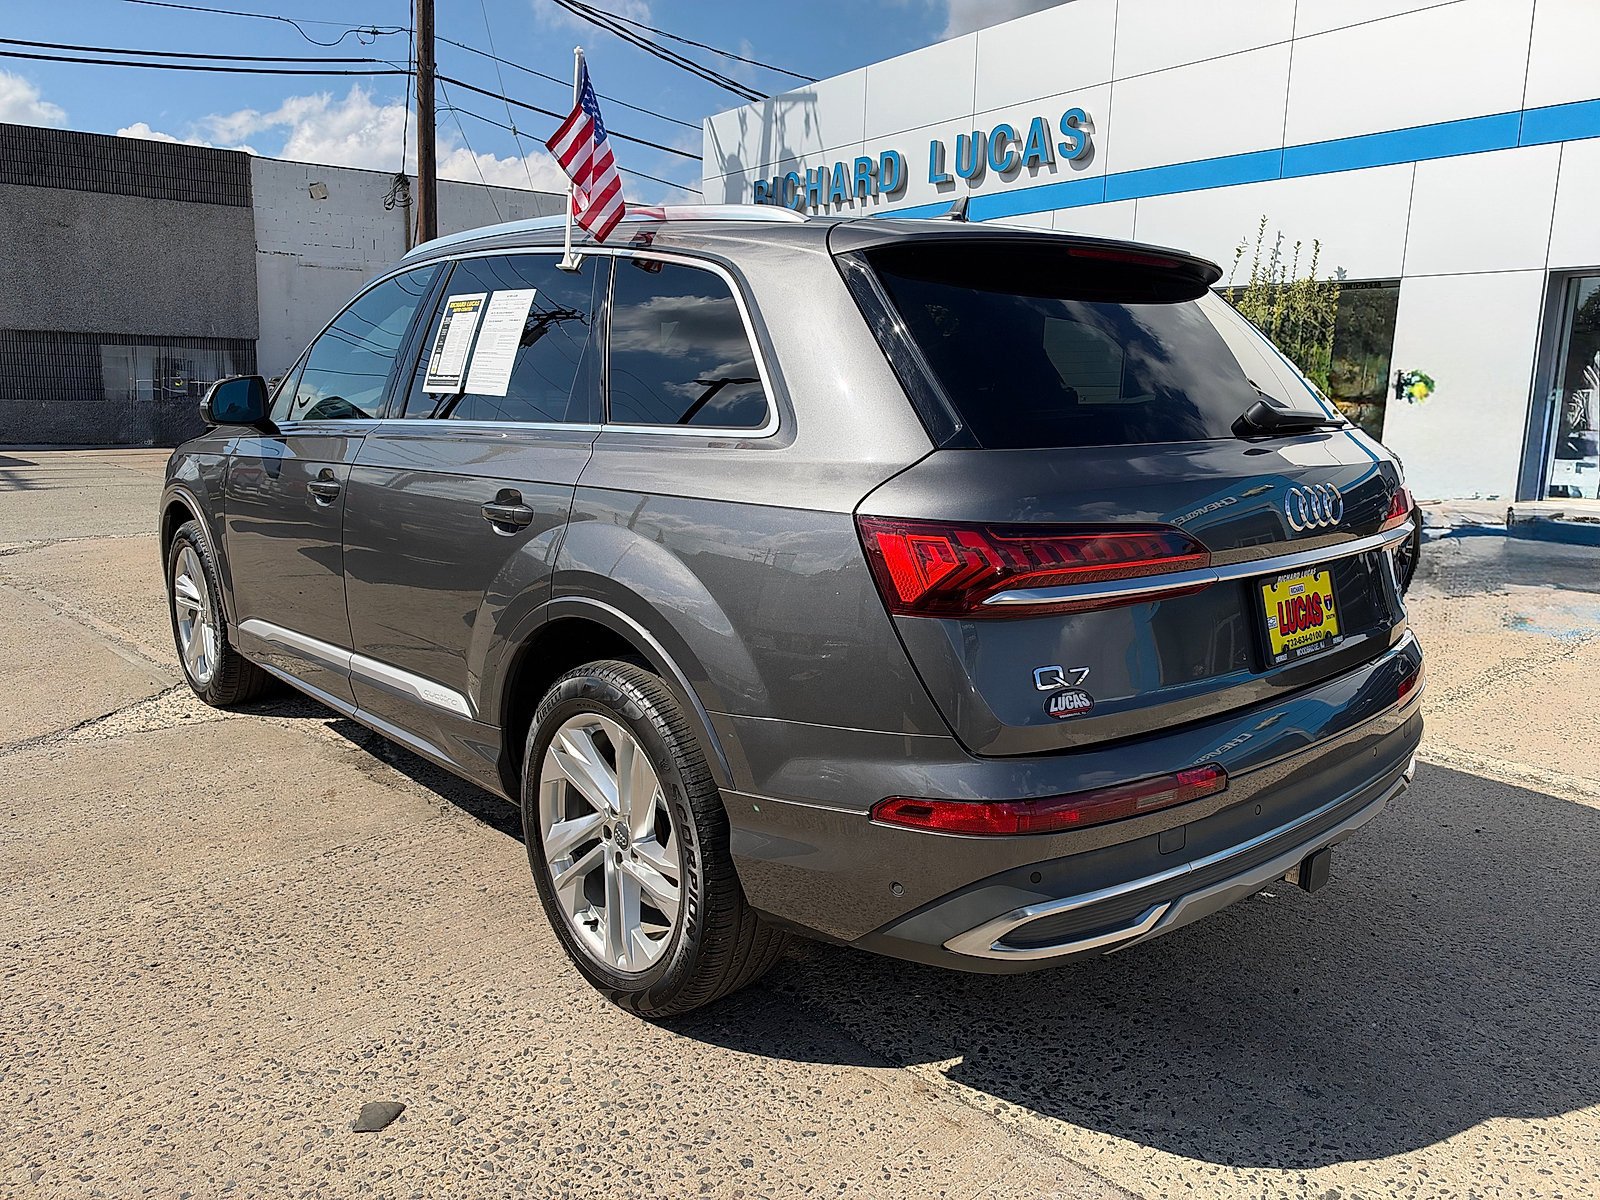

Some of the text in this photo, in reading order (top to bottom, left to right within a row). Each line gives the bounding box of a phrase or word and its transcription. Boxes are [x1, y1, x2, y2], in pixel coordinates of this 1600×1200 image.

[753, 107, 1094, 211] RICHARD LUCAS
[450, 301, 466, 309] RICHARD
[1277, 568, 1316, 583] RICHARD LUCAS
[1277, 592, 1323, 637] LUCAS
[1326, 600, 1331, 610] 1
[1287, 630, 1322, 647] 732-634-0100
[1032, 665, 1090, 691] Q7
[423, 689, 458, 706] quattro
[1050, 692, 1091, 713] LUCAS
[671, 784, 699, 941] SCORPION
